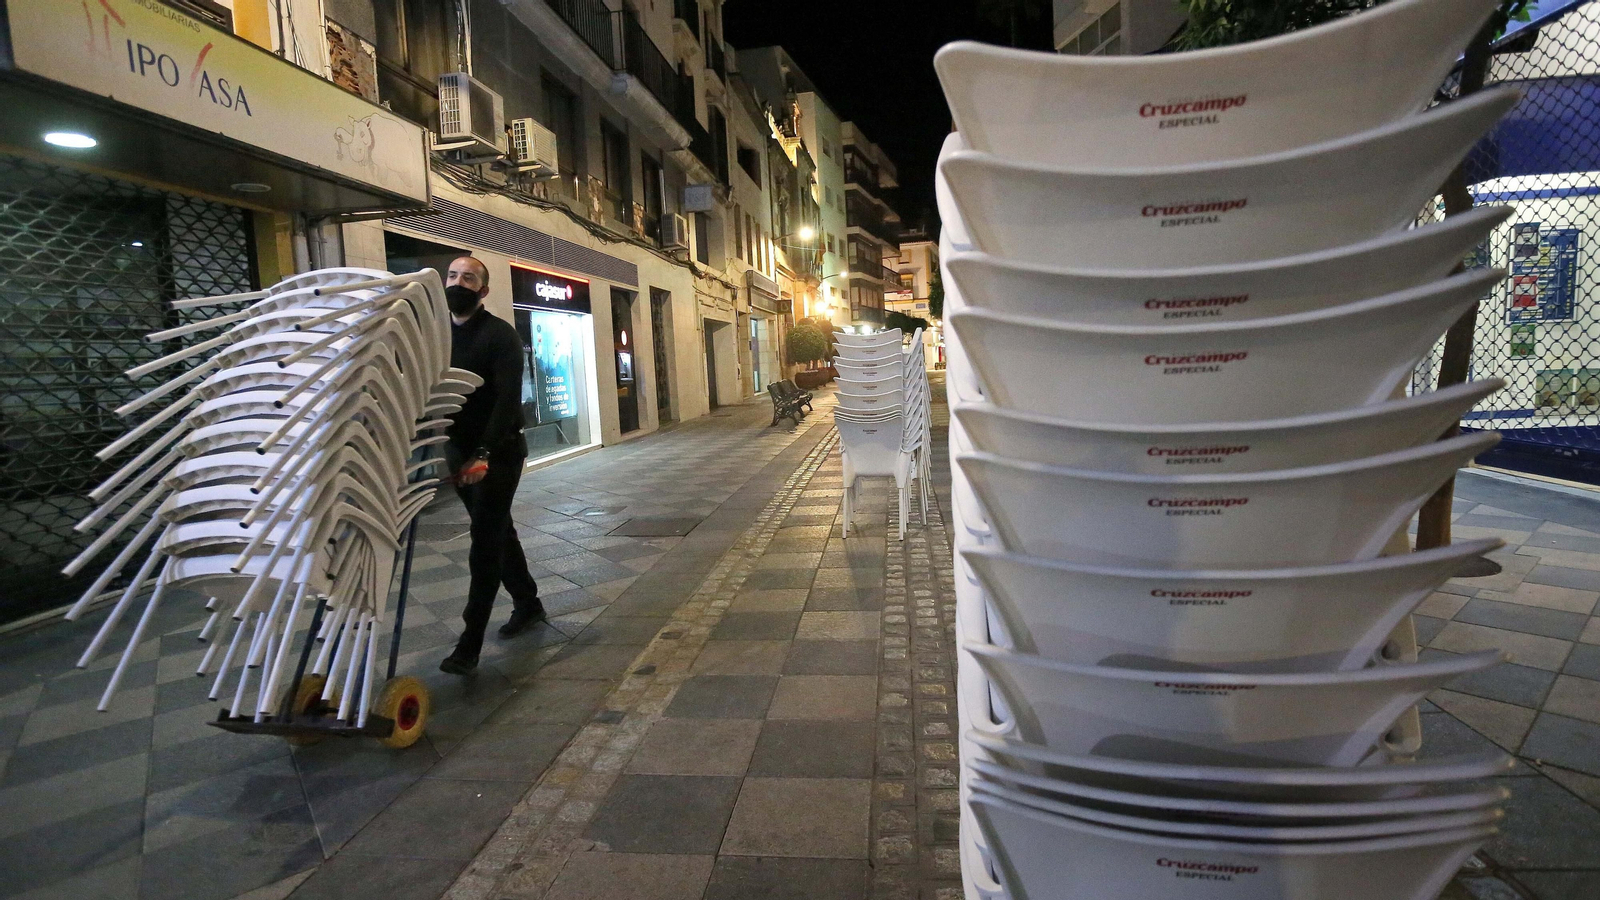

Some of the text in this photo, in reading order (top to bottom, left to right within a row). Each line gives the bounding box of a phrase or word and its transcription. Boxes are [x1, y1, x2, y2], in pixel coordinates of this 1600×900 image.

[1139, 93, 1247, 117] Cruzcampo
[1159, 115, 1220, 129] ESPECIAL
[1141, 197, 1248, 217] Cruzcampo
[1160, 215, 1221, 228] ESPECIAL
[1144, 293, 1250, 310] Cruzcampo
[1163, 309, 1223, 319] ESPECIAL
[1144, 351, 1249, 366] Cruzcampo
[1163, 365, 1222, 375] ESPECIAL
[545, 384, 567, 394] deegadas
[1147, 445, 1250, 456] Cruzcampo
[1166, 457, 1224, 465] ESPECIAL
[1147, 497, 1249, 508] Cruzcampo
[1166, 509, 1224, 517] ESPECIAL
[1150, 588, 1253, 599] Cruzcampo
[1156, 857, 1260, 874] Cruzcampo
